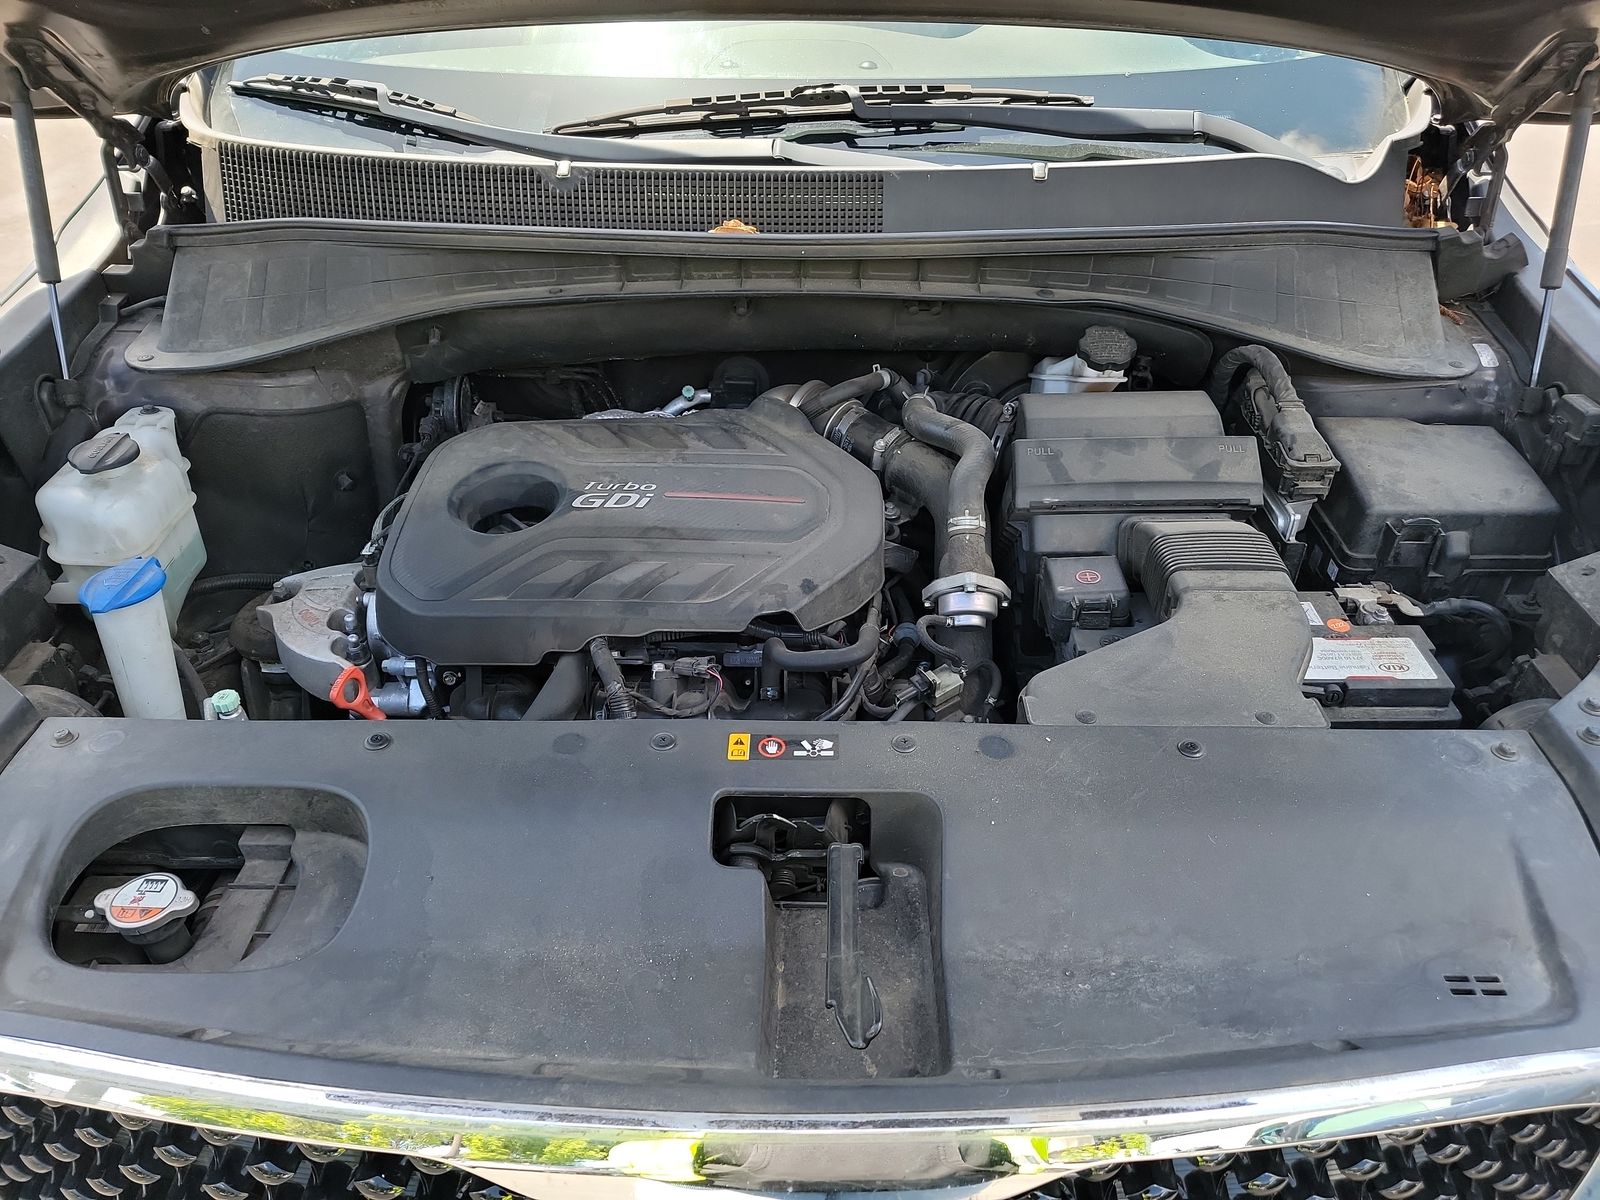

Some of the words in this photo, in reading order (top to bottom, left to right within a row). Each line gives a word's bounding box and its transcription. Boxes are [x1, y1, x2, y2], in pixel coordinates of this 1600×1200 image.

[1027, 447, 1054, 456] PULL
[1218, 444, 1245, 453] PULL
[584, 481, 657, 491] Turbo
[571, 492, 655, 508] GDi
[1382, 663, 1407, 672] KIA
